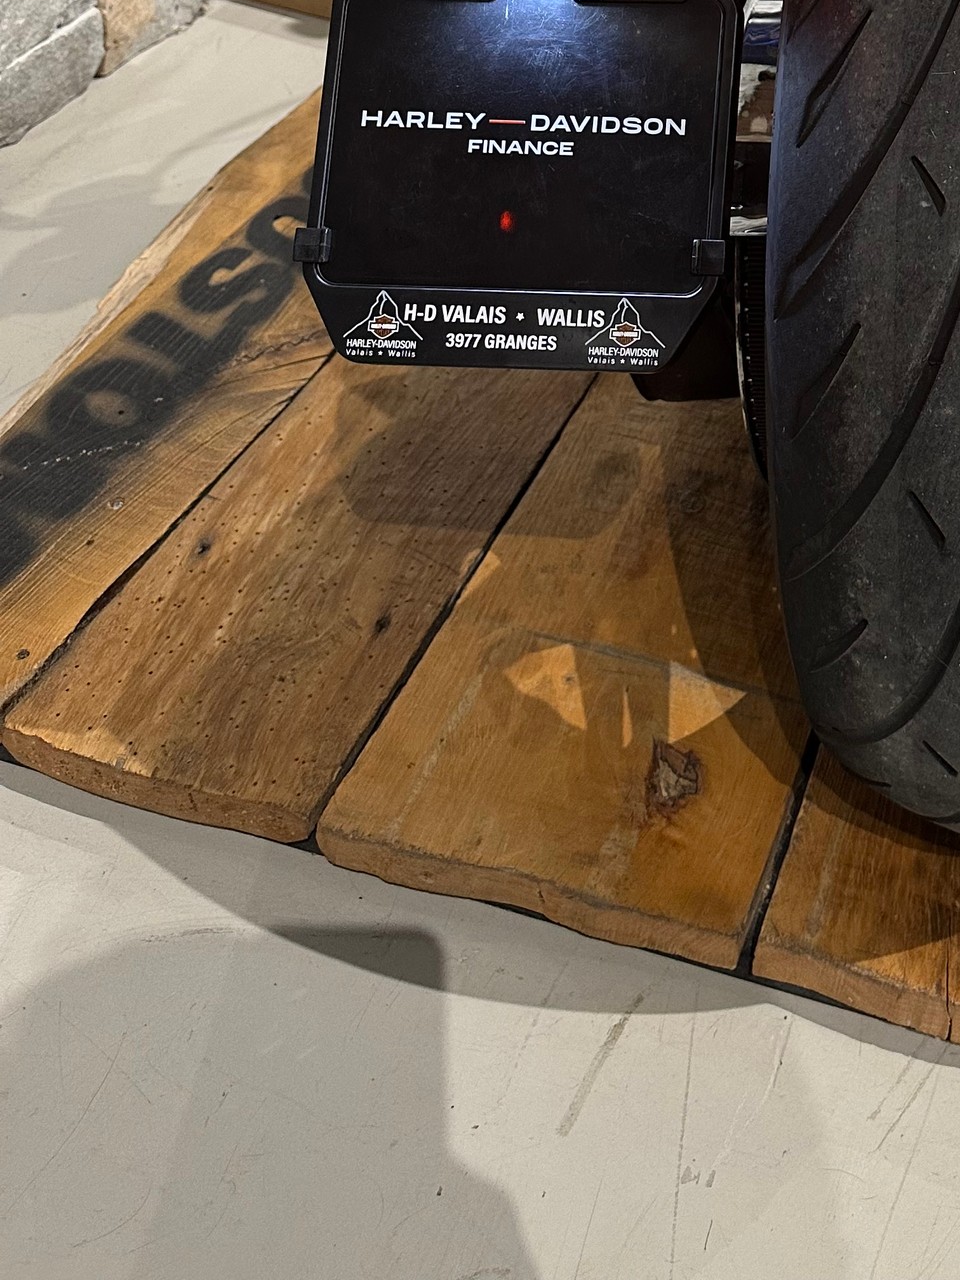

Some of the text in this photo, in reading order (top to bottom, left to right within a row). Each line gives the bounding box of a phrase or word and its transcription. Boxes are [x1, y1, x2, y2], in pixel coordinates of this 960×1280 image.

[467, 138, 575, 156] FINANCE
[403, 303, 606, 328] H-D VALAIS WALLIS
[346, 338, 417, 349] HARLEY-DAVIDSON
[445, 332, 558, 351] 3977 GRANGES
[345, 348, 416, 358] Valais Wallis
[588, 346, 659, 357] HARLEY-DAVIDSON
[587, 356, 659, 366] Valais Wallis
